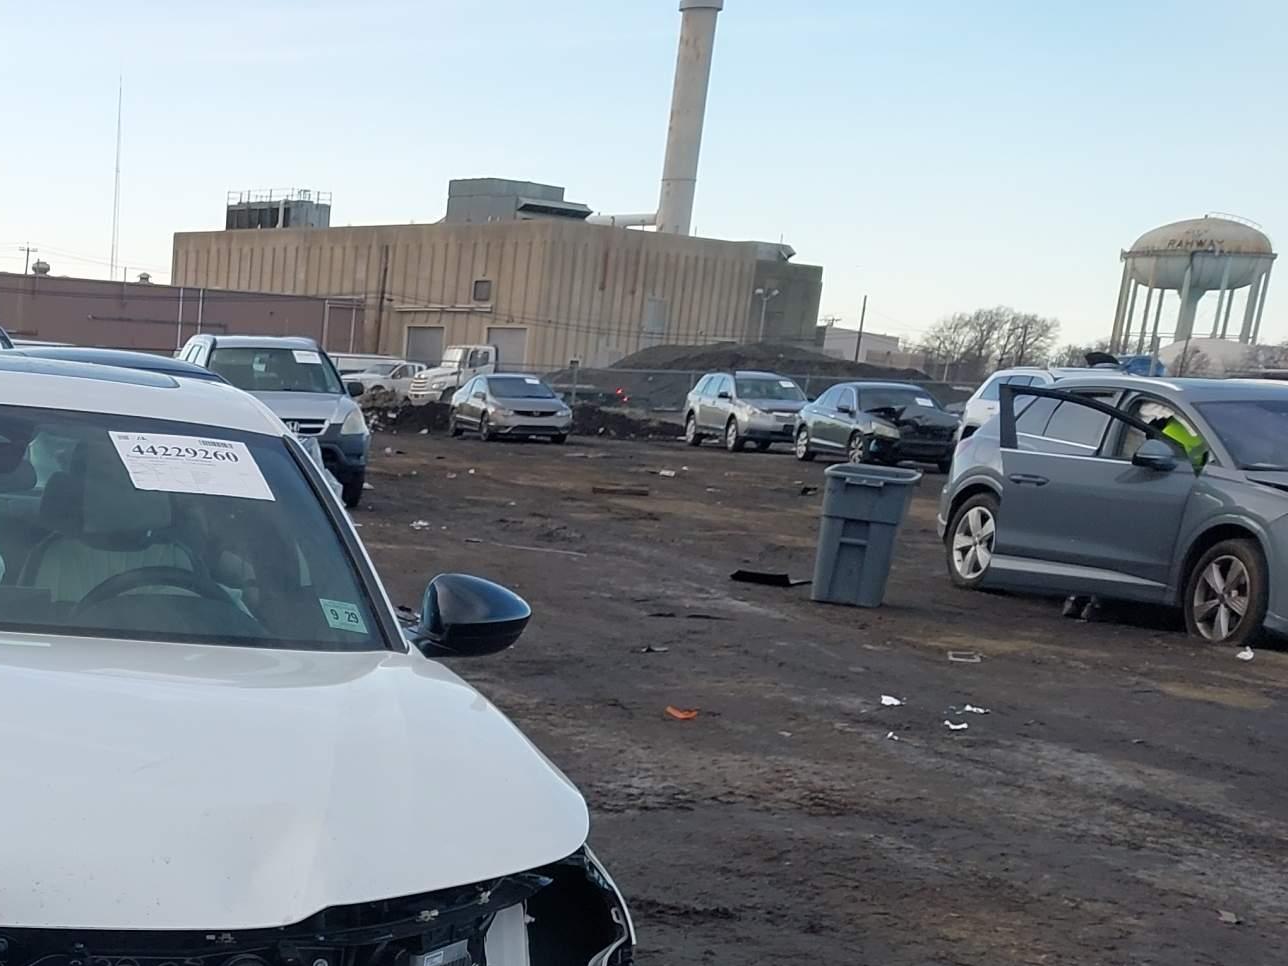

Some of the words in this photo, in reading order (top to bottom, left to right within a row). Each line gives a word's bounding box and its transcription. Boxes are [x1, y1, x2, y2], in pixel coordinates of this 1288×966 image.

[1167, 239, 1225, 249] RAHWAY
[132, 443, 239, 464] 44229260
[329, 608, 340, 621] 9
[344, 610, 359, 624] 29
